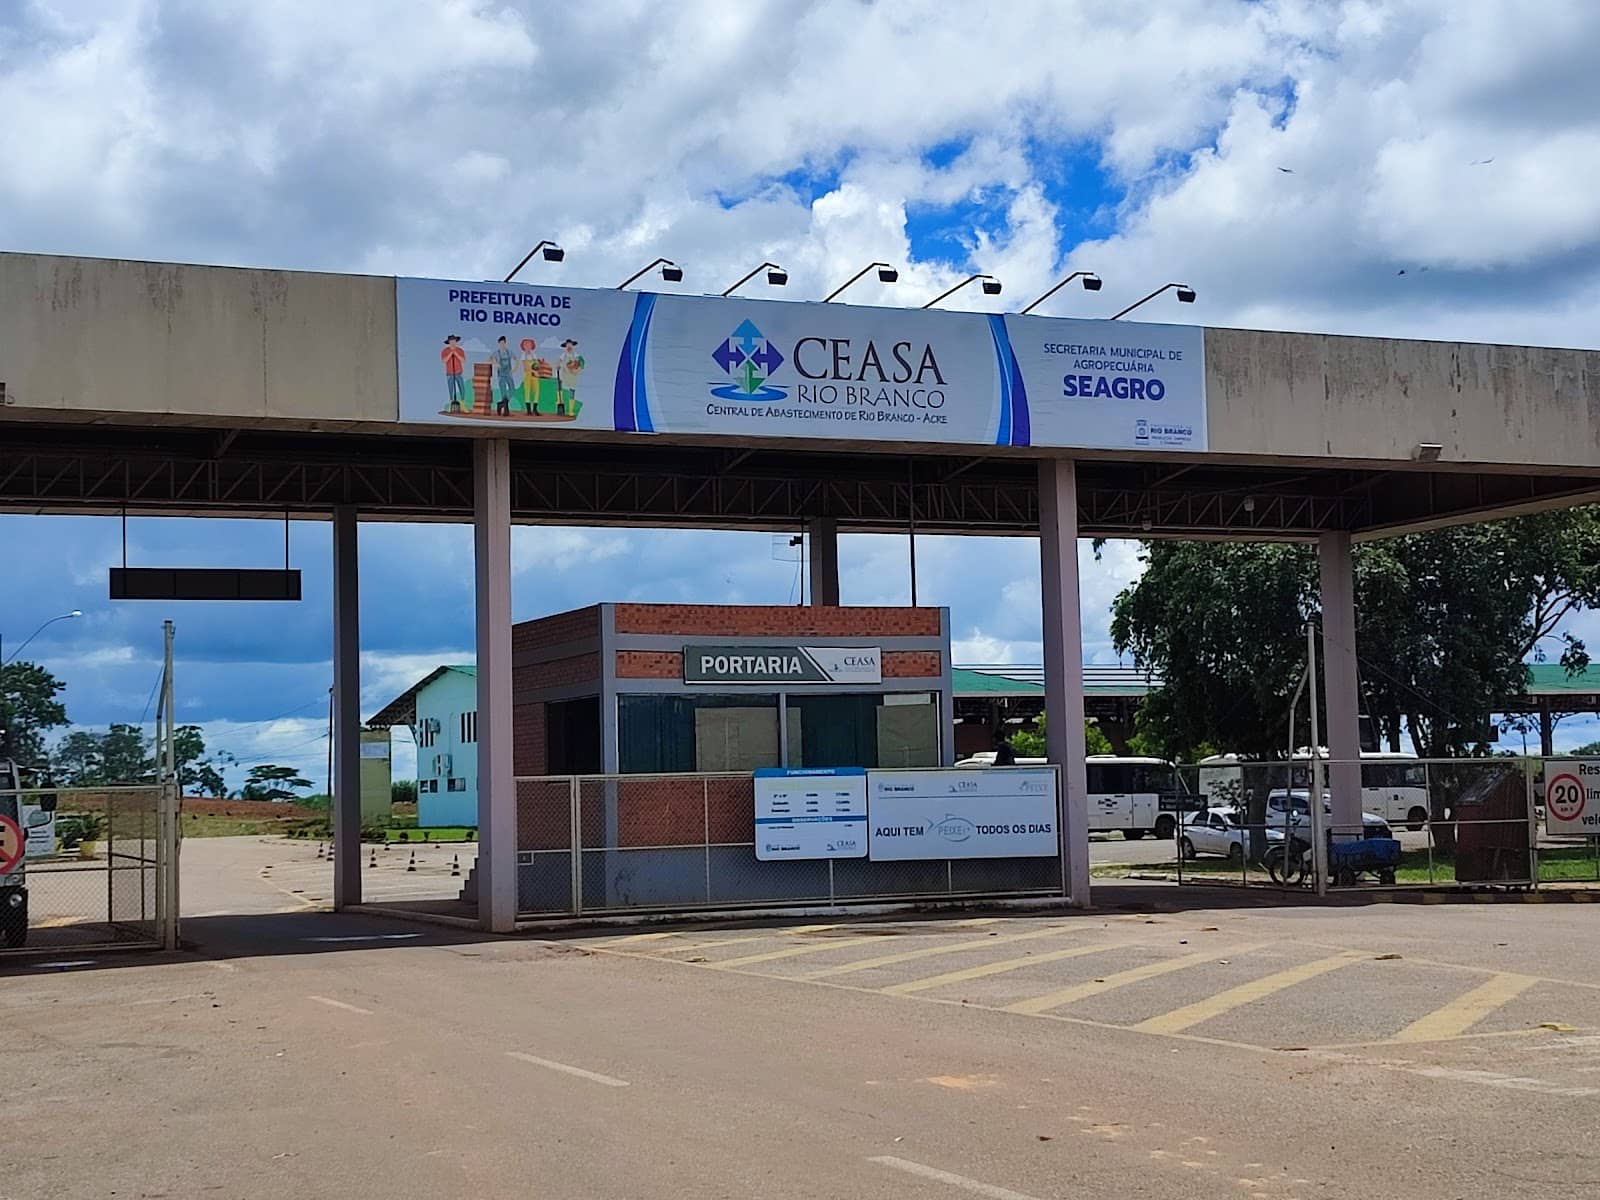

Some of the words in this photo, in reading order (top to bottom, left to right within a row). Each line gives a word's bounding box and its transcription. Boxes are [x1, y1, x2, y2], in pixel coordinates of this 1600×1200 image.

[449, 289, 545, 307] PREFEITURA
[551, 295, 571, 309] DE
[460, 308, 488, 322] RIO
[493, 310, 561, 326] BRANCO
[793, 337, 948, 385] CEASA
[1044, 343, 1107, 356] SECRETARIA
[1110, 346, 1165, 360] MUNICIPAL
[1168, 351, 1183, 361] DE
[1073, 358, 1154, 373] AGROPECUÁRIA
[798, 384, 838, 404] RIO
[846, 385, 945, 409] BRANCO
[1063, 374, 1165, 401] SEAGRO
[706, 403, 749, 416] CENTRAL
[751, 407, 764, 417] DE
[766, 406, 843, 421] ABASTECIMENTO
[844, 411, 857, 421] DE
[858, 410, 875, 422] RIO
[877, 410, 915, 424] BRANCO
[923, 413, 948, 424] ACRE
[701, 656, 804, 675] PORTARIA
[844, 656, 876, 666] CEASA
[1555, 785, 1579, 804] 20
[876, 827, 901, 837] AQUI
[903, 826, 924, 836] TEM
[976, 825, 1009, 835] TODOS
[1012, 825, 1026, 834] OS
[1029, 823, 1051, 833] DIAS
